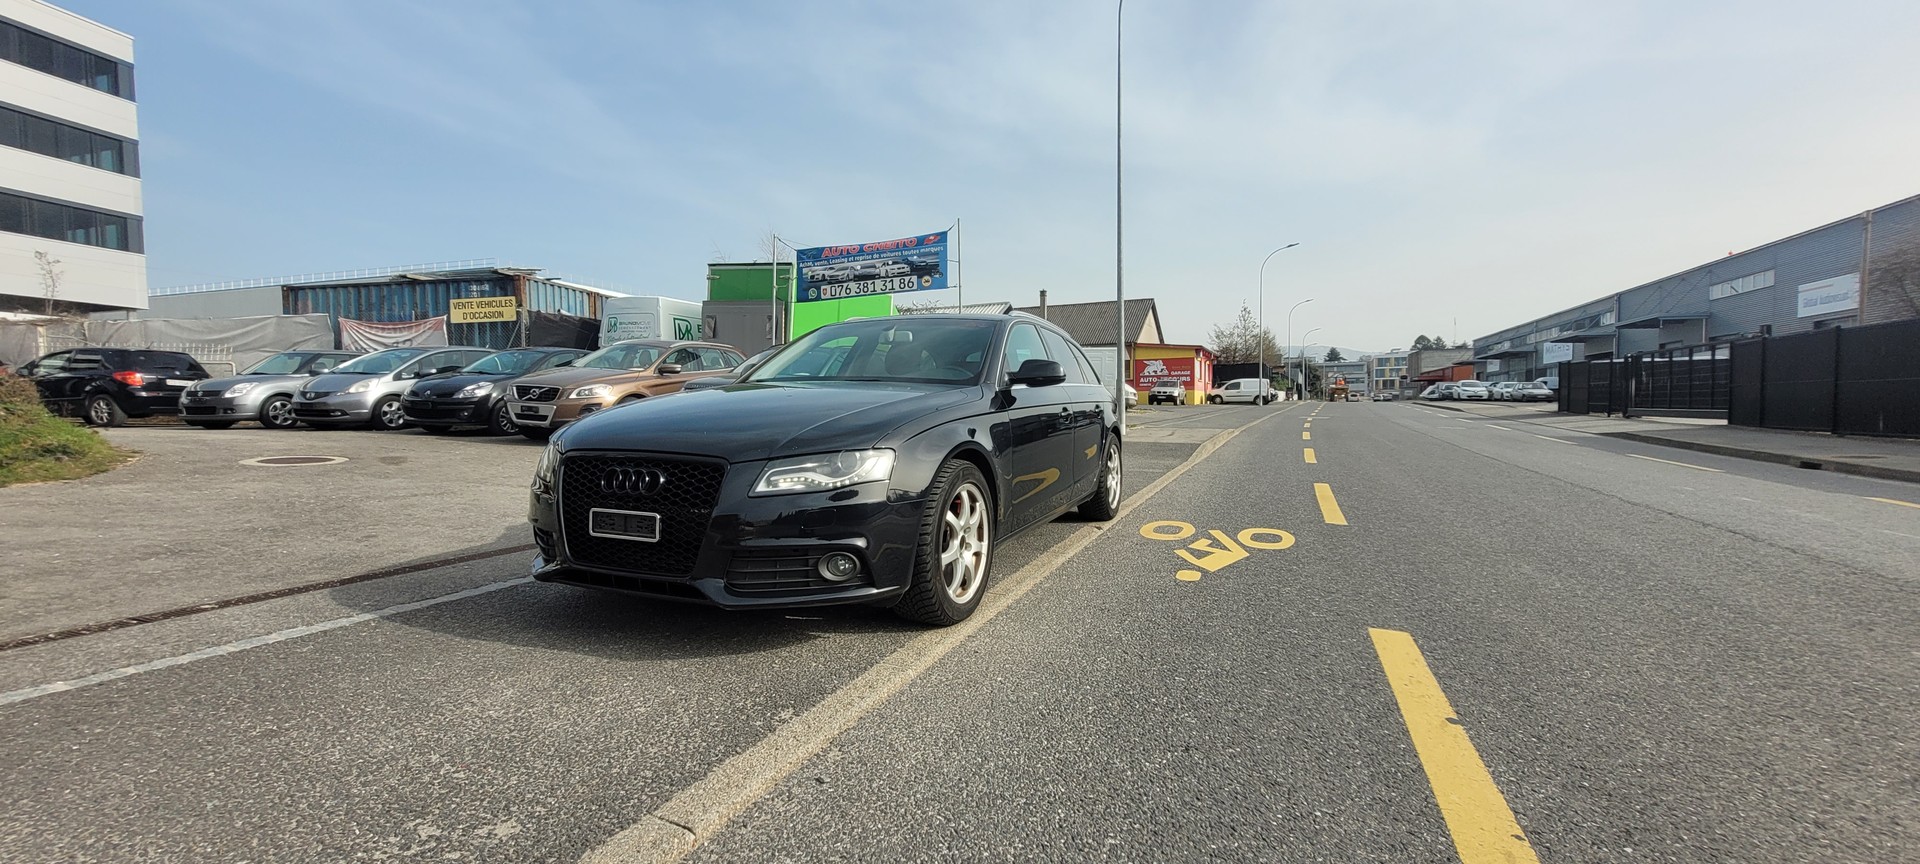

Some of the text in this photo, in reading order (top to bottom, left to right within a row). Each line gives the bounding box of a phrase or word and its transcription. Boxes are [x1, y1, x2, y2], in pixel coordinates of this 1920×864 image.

[822, 245, 860, 258] AUTO
[830, 256, 847, 264] Leasing
[855, 253, 872, 261] reprise
[881, 249, 902, 257] voitures
[830, 277, 914, 297] 076 381 31 86
[453, 299, 513, 310] VENTE VEHICULES
[463, 310, 504, 320] D'OCCASION
